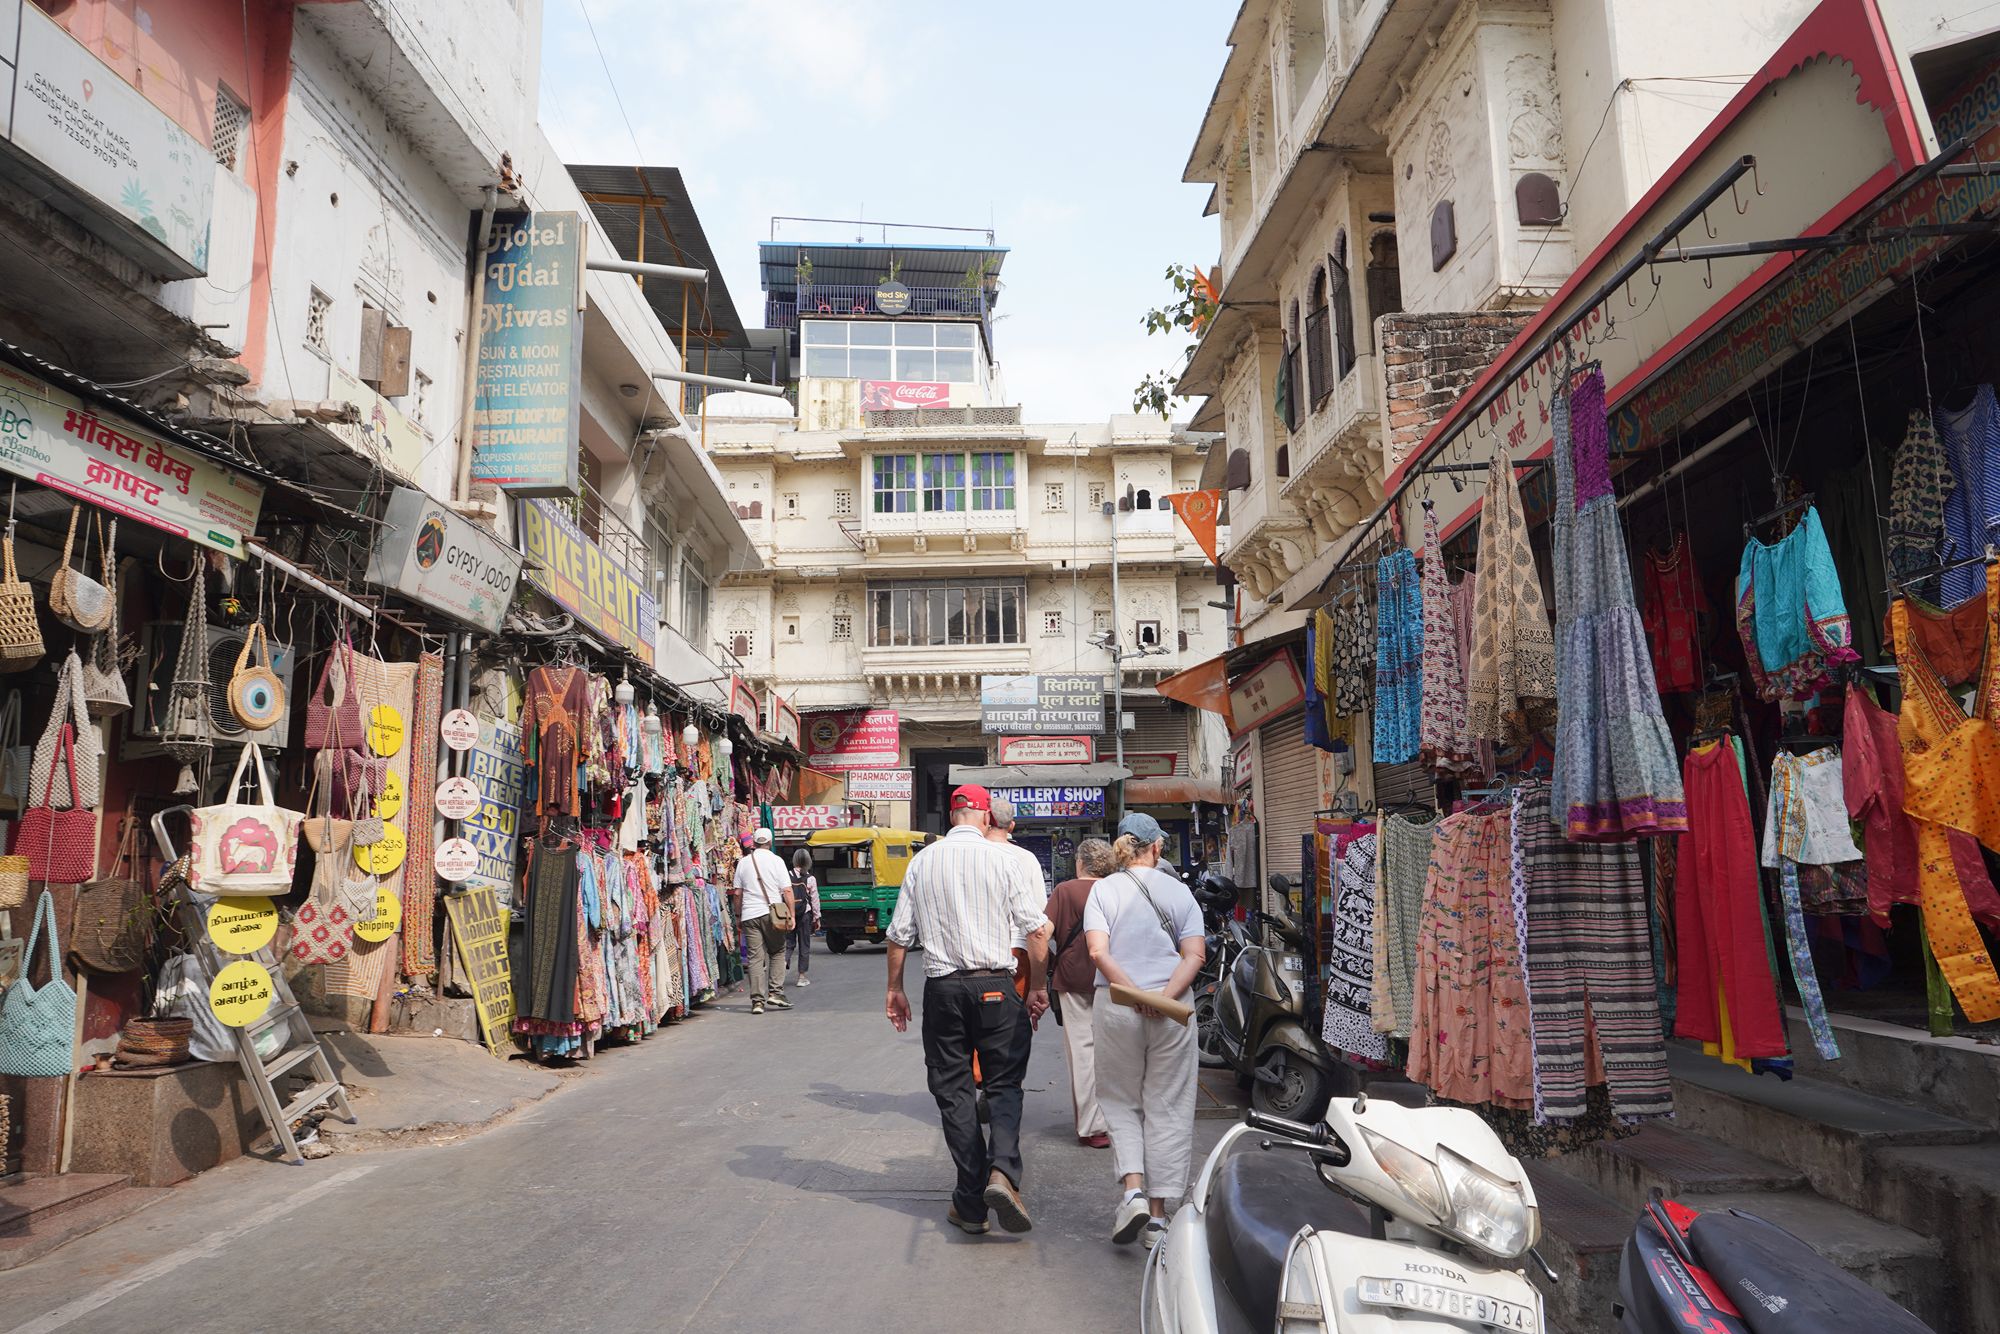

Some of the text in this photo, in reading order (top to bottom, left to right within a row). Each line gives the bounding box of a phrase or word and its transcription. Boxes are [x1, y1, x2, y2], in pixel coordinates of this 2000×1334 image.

[34, 72, 79, 113] GANGAUR
[81, 109, 104, 132] GHAT
[24, 80, 62, 114] JAGDISH
[103, 138, 138, 171] UDAIPUR
[92, 145, 118, 168] 97079
[488, 221, 565, 254] Hotel
[487, 261, 560, 292] Udai
[894, 291, 908, 300] Sky
[481, 303, 568, 334] Niwas
[480, 345, 560, 360] SUN & MOON
[478, 363, 561, 379] RESTAURANT
[504, 382, 569, 397] ELEVATOR
[895, 384, 938, 400] Coca-Cola
[500, 464, 513, 475] ON
[447, 546, 482, 577] GYPSY
[481, 565, 511, 592] JODO
[525, 500, 584, 590] BIKE
[585, 540, 641, 634] RENT
[1039, 695, 1066, 709] पूल
[864, 714, 895, 725] कलाप
[985, 708, 1039, 721] बालाजी
[843, 736, 896, 745] Karm Kalap
[474, 750, 523, 788] BIKE
[850, 772, 912, 781] PHARMACY SHOP
[489, 778, 523, 806] RENT
[849, 790, 911, 799] SWARAJ MEDICALS
[987, 787, 1102, 802] EWELLERY SHOP
[464, 825, 513, 861] TAXI
[452, 889, 499, 928] TAXI
[229, 923, 263, 934] விலை
[358, 920, 395, 932] Shipping
[221, 977, 259, 992] வாழ்க
[1404, 1262, 1468, 1284] HONDA
[1657, 1247, 1702, 1297] NTORQ
